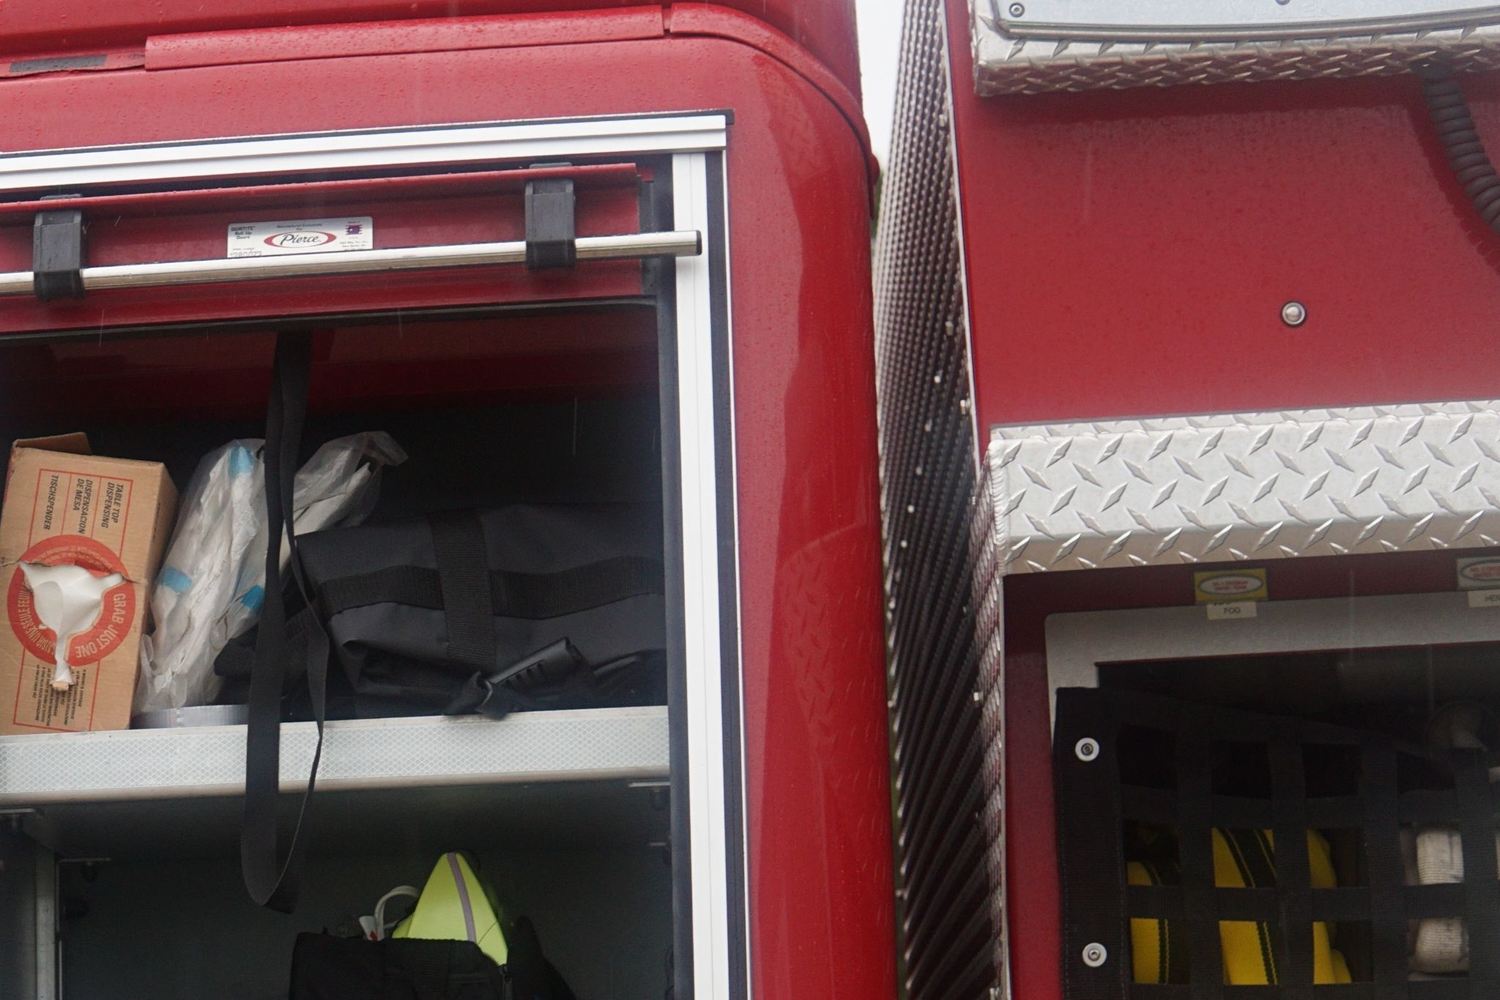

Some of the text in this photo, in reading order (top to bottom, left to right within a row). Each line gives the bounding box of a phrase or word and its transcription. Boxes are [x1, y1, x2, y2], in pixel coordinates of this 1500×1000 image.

[280, 233, 320, 246] Pierce
[43, 475, 59, 530] TISCHSPENDER
[73, 478, 84, 511] DE MESA
[78, 479, 93, 534] DISPENSACION
[101, 482, 115, 528] DISPENSING
[111, 484, 124, 523] TABLE TOP
[75, 593, 127, 658] GRAB JUST ONE
